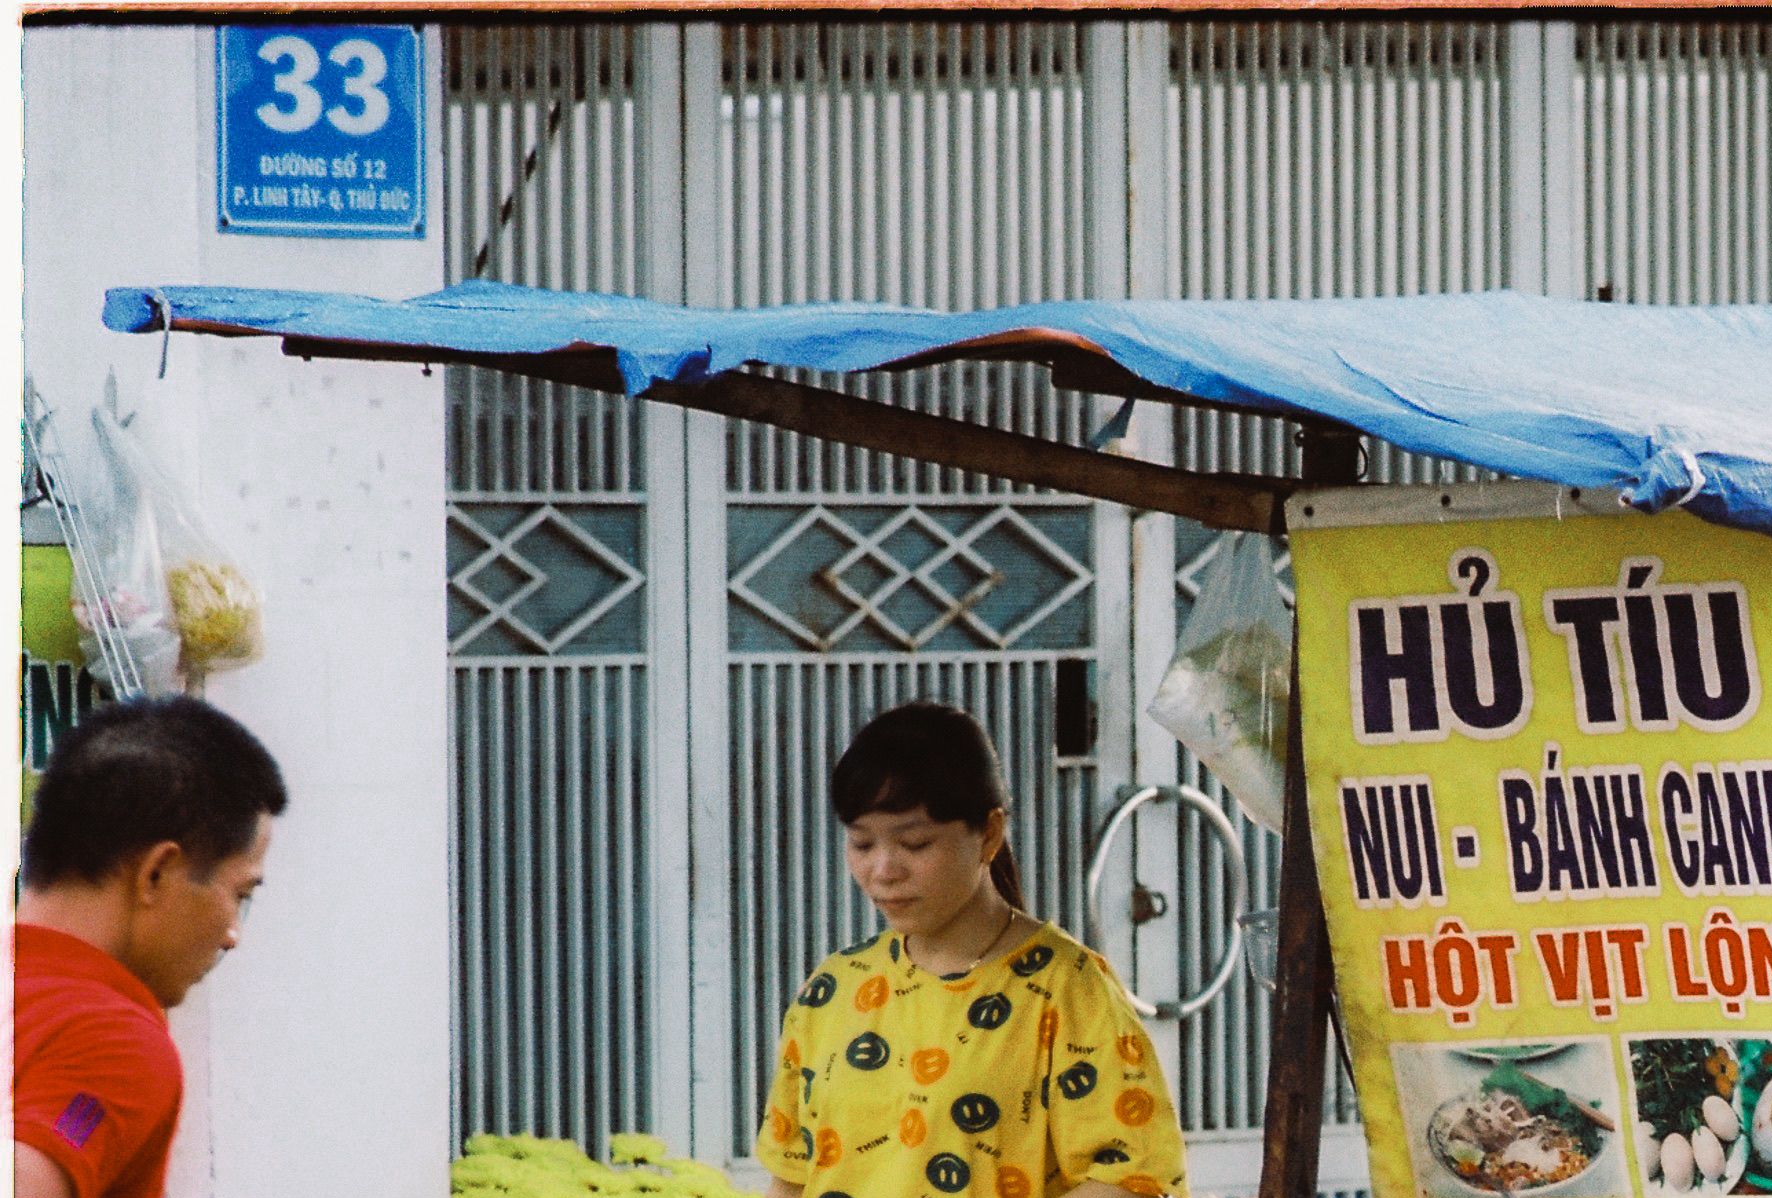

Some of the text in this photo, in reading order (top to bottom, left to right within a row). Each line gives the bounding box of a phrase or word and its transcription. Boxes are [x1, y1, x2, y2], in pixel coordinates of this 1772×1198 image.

[256, 35, 391, 136] 33
[233, 186, 250, 206] P.
[252, 186, 289, 208] LINH
[331, 151, 358, 179] SỐ
[363, 159, 387, 180] 12
[1357, 556, 1753, 736] HỦ TÍU
[1342, 782, 1446, 901] NUI
[1501, 750, 1658, 893] BÁNH
[1384, 920, 1517, 1024] HỘT
[1536, 928, 1646, 1017] VỊT
[856, 1134, 890, 1154] THINK
